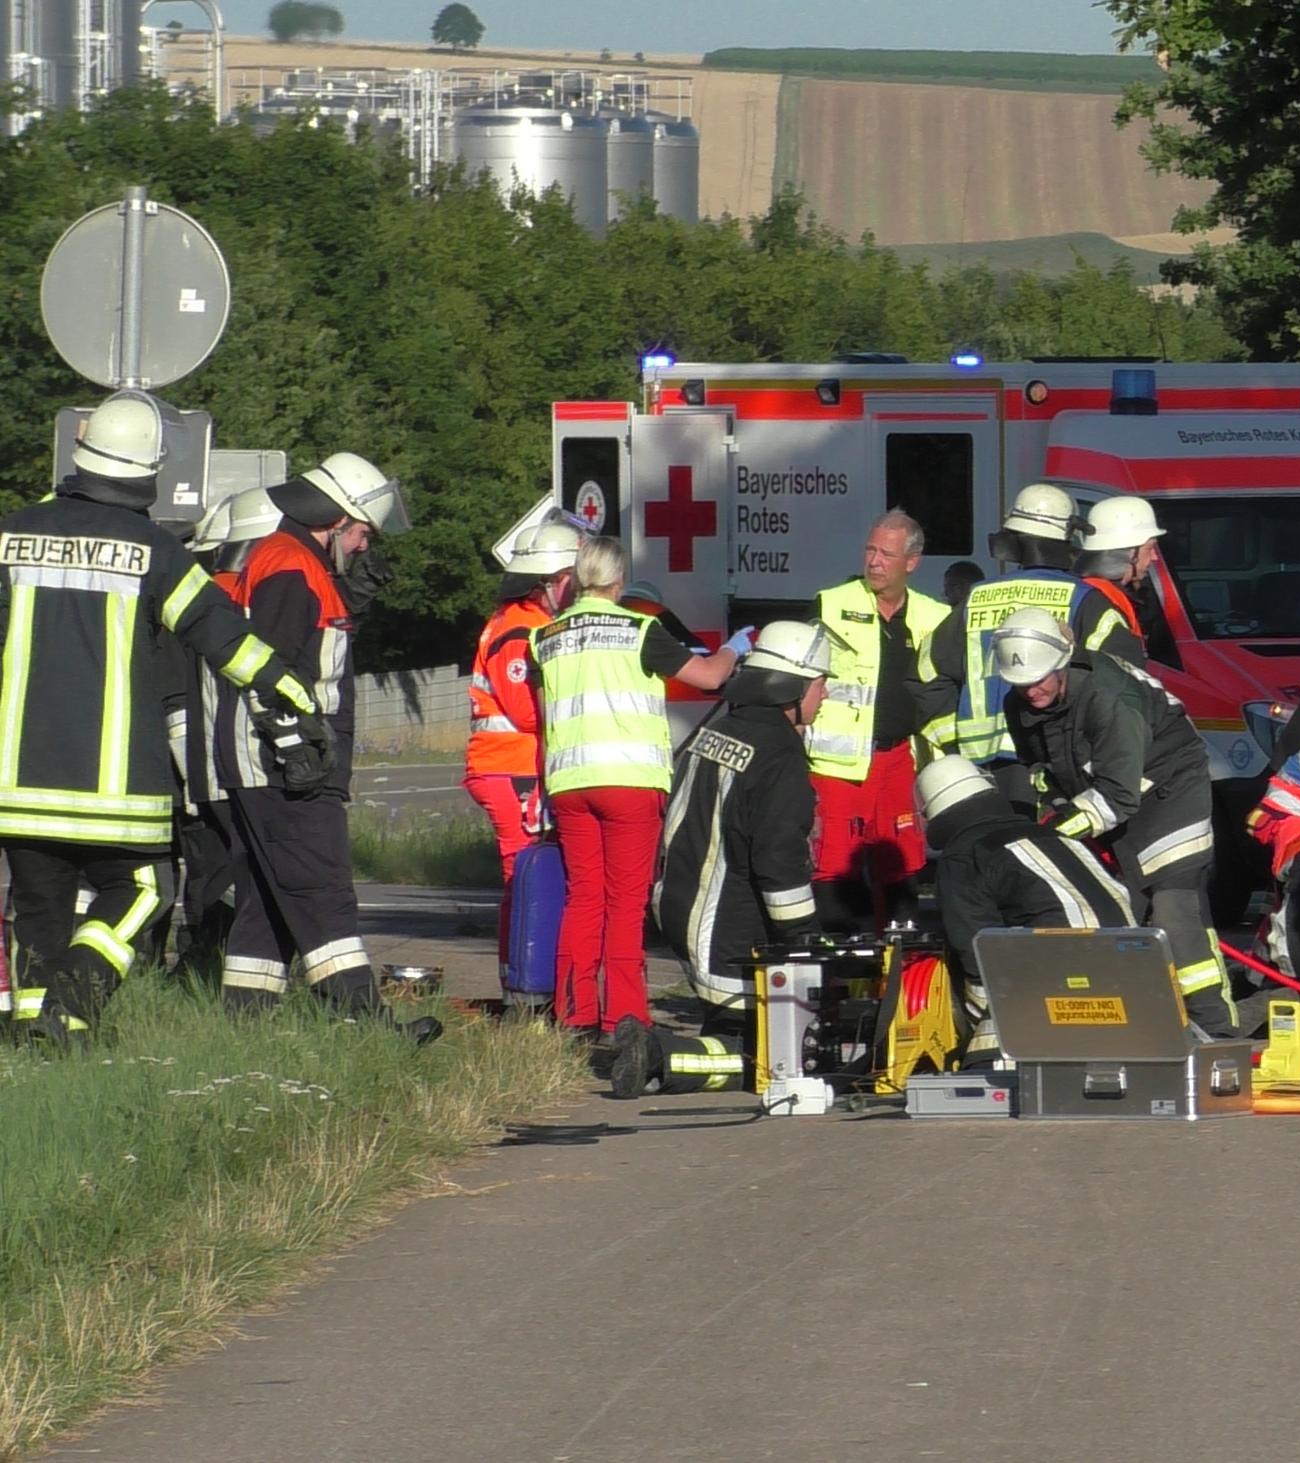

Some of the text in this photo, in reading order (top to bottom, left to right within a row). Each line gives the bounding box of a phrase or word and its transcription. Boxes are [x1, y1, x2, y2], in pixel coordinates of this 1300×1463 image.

[1177, 429, 1252, 446] Bayerisches
[1252, 428, 1286, 441] Rotes
[737, 465, 848, 501] Bayerisches
[737, 504, 790, 535] Rotes
[737, 543, 790, 574] Kreuz
[971, 584, 1069, 604] GRUPPENFÜHRER
[970, 610, 987, 629] FF
[592, 632, 637, 645] Member
[1011, 651, 1024, 667] A
